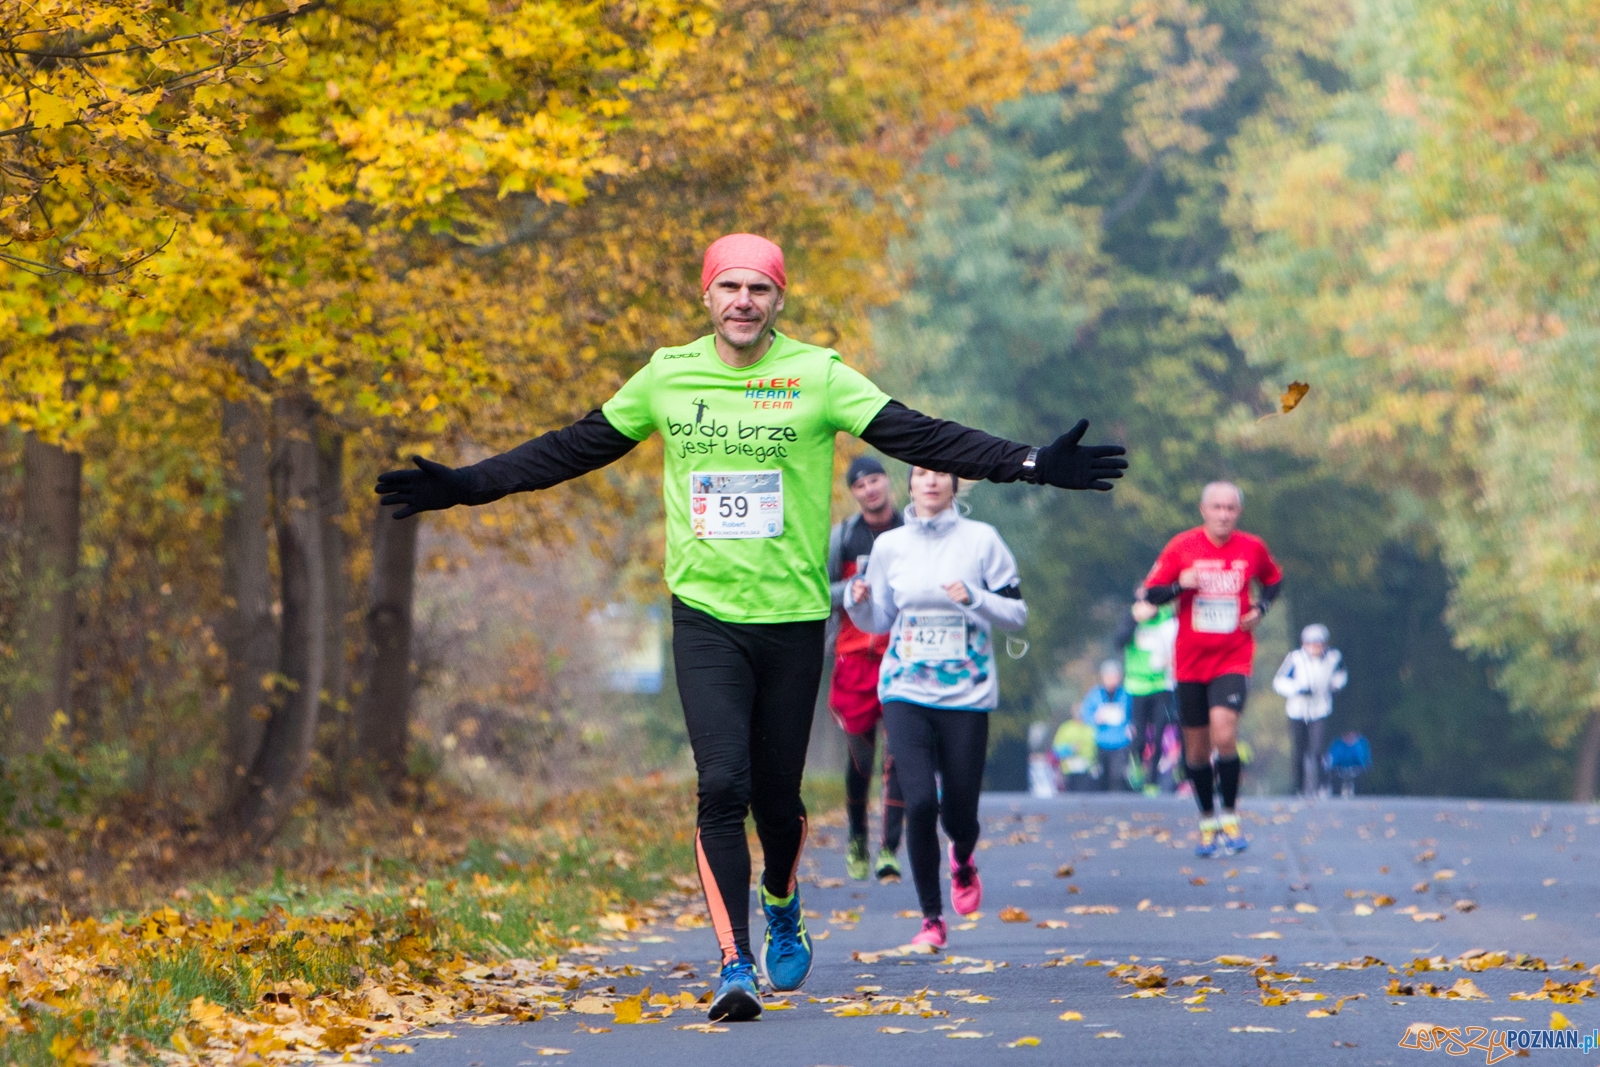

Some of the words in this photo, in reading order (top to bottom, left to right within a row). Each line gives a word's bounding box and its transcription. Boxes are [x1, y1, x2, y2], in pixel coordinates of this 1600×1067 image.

[745, 390, 801, 399] HERNIK
[753, 401, 793, 409] TEAM
[739, 420, 798, 442] brze
[678, 438, 718, 459] jest
[724, 439, 788, 463] biegać
[719, 496, 748, 518] 59
[915, 630, 947, 645] 427
